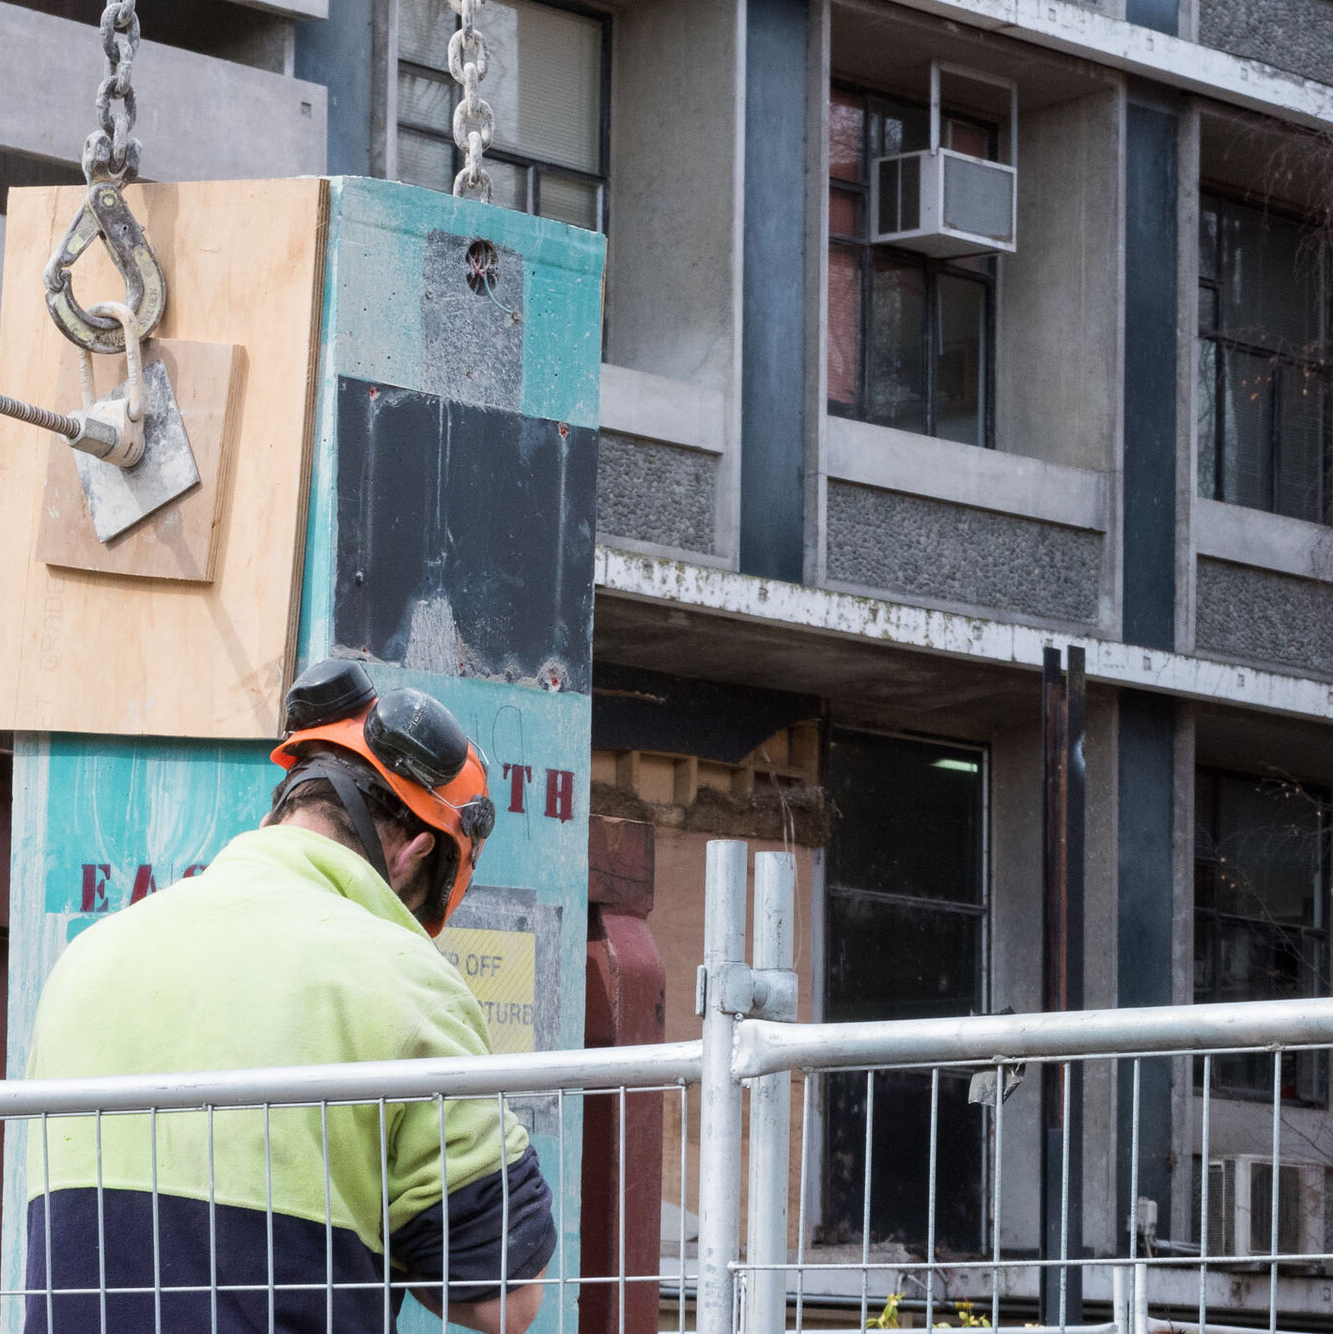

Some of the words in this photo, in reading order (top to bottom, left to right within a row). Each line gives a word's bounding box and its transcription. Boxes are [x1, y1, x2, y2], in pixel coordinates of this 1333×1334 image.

[503, 763, 575, 823] TH
[80, 863, 210, 913] EA
[465, 953, 502, 978] OFF
[478, 1001, 534, 1026] TURE
